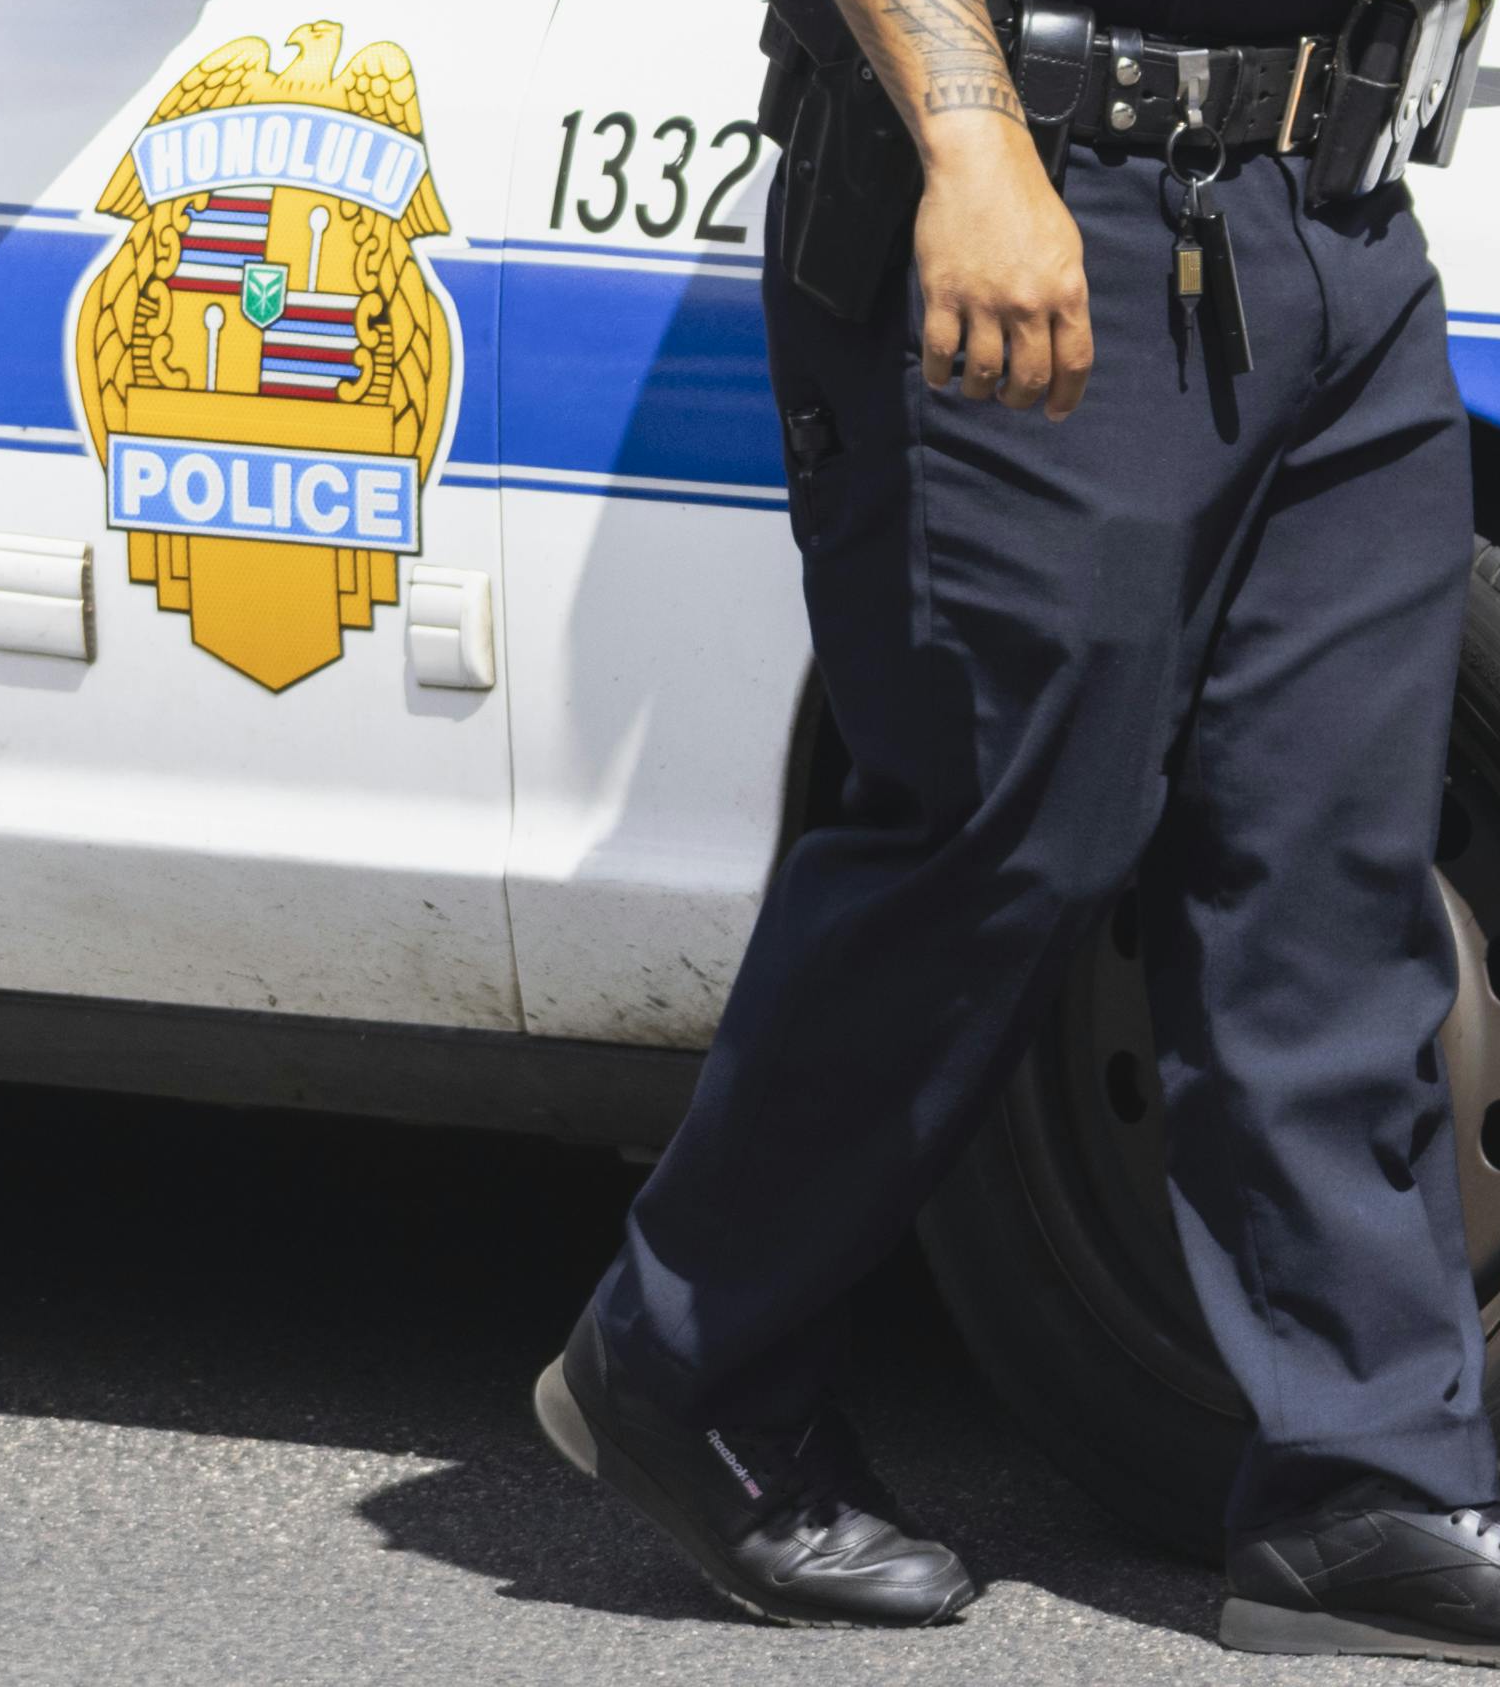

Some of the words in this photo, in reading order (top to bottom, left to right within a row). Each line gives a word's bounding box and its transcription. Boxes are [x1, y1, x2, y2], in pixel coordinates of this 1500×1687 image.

[153, 116, 415, 201] HONOLULU
[550, 109, 761, 243] 1332
[123, 450, 403, 538] POLICE
[706, 1429, 749, 1481] Reebok
